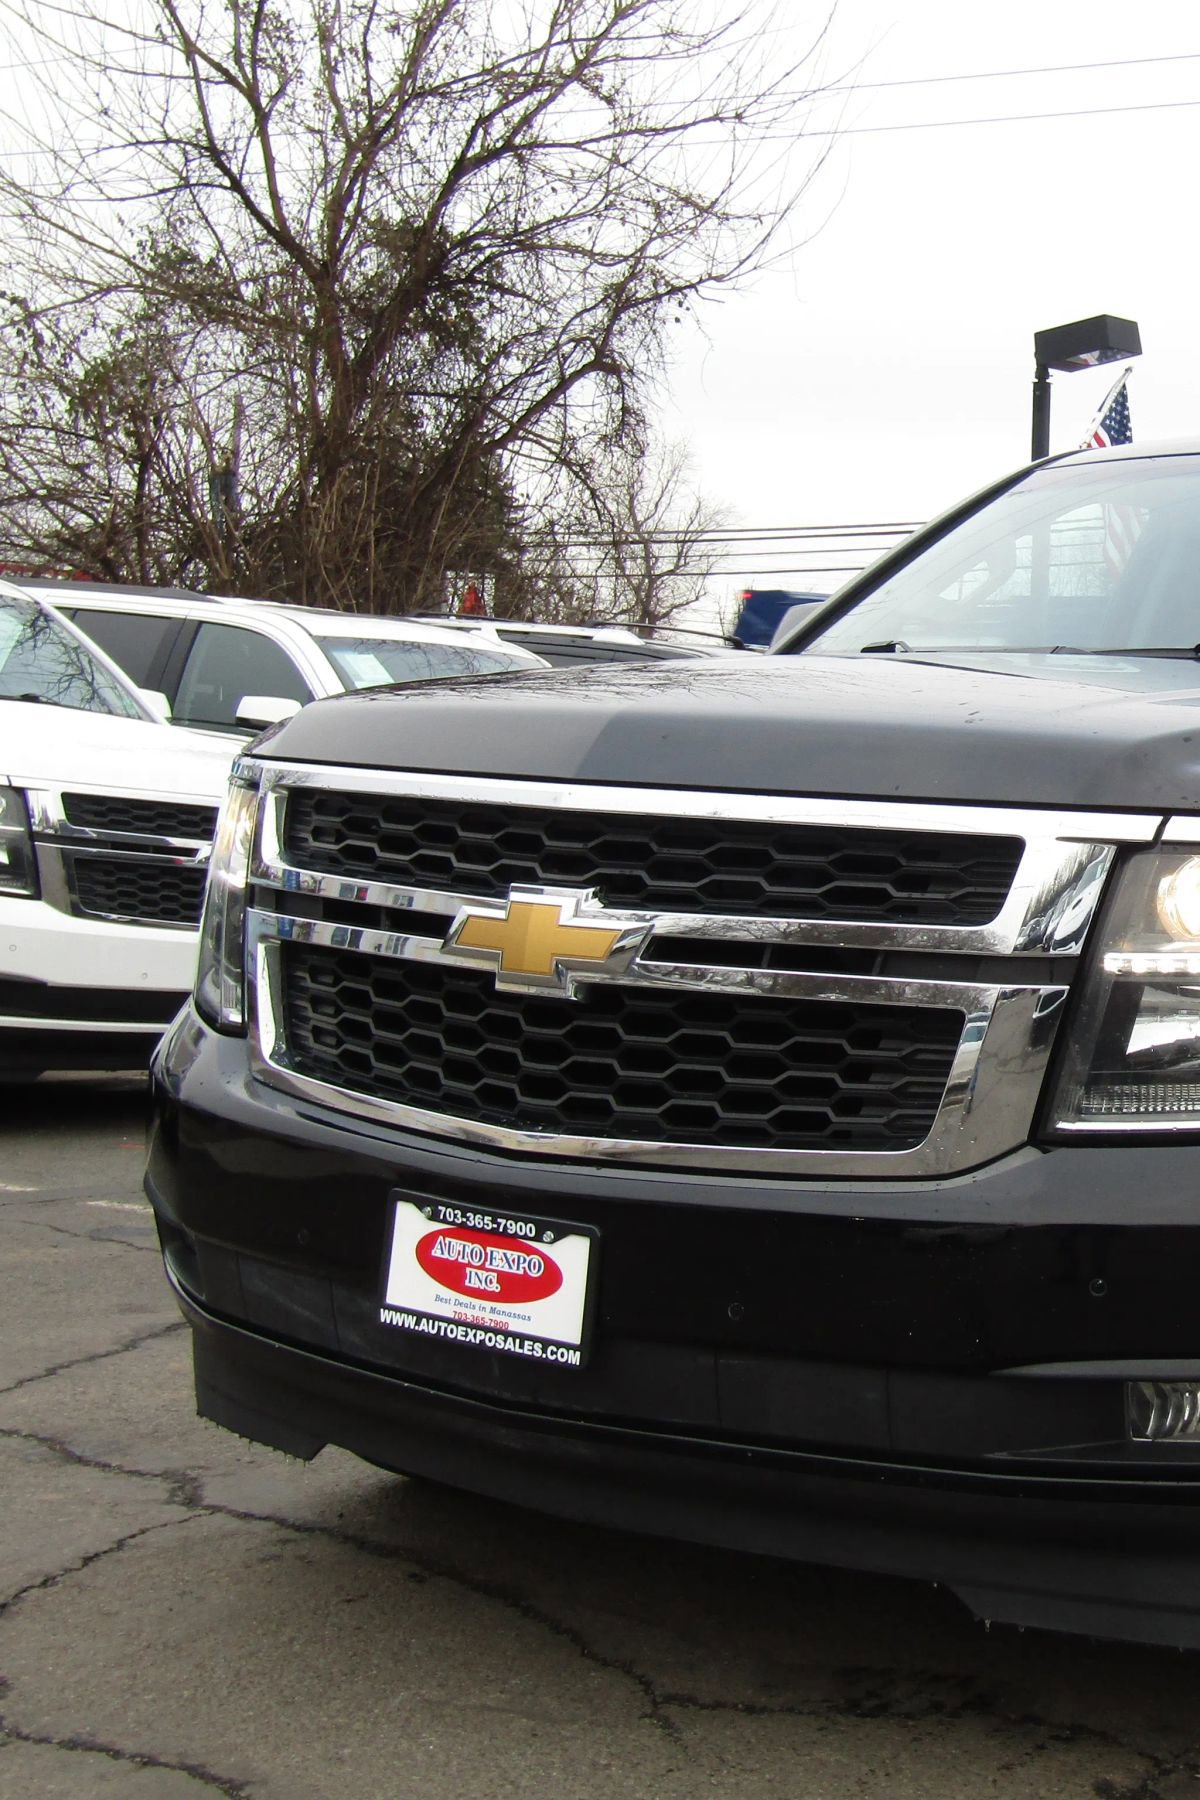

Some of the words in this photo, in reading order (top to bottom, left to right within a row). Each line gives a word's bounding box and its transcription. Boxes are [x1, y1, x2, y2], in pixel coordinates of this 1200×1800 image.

[438, 1206, 536, 1238] 703-365-7900
[432, 1236, 484, 1266] AUTO
[485, 1247, 544, 1277] EXPO
[465, 1268, 500, 1292] INC.
[434, 1294, 451, 1305] Best
[453, 1299, 476, 1311] Deals
[478, 1304, 487, 1313] in
[489, 1306, 532, 1322] Manassas
[452, 1311, 510, 1330] 703-365-7900
[380, 1308, 581, 1366] WWW.AUTOEXPOSALES.COM
